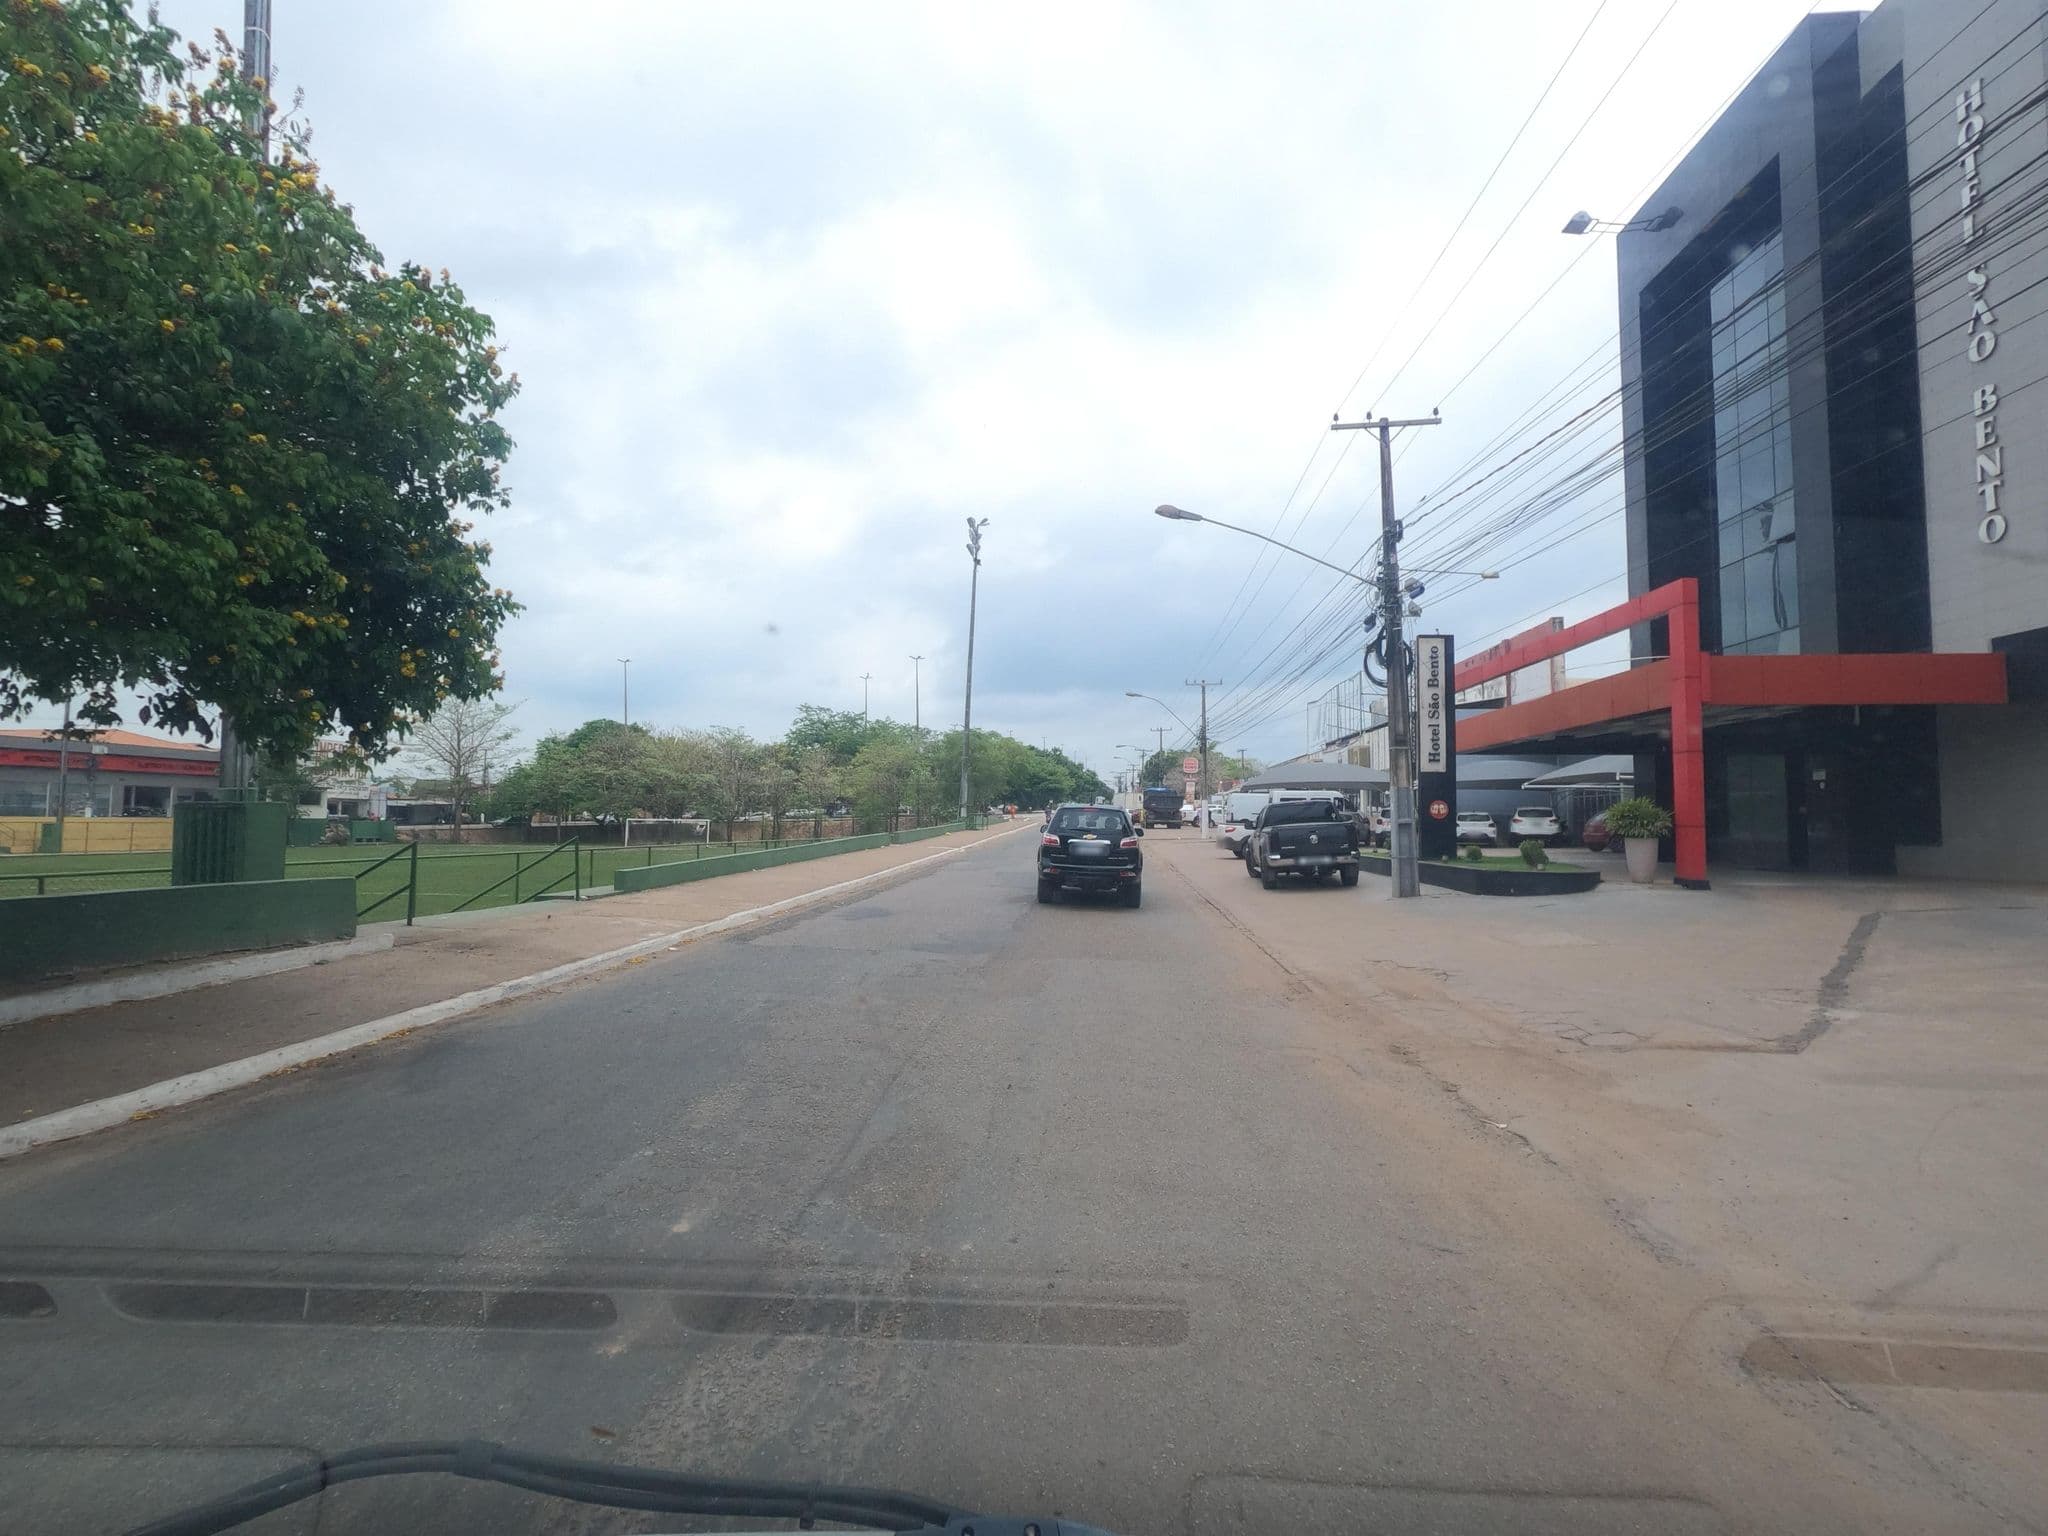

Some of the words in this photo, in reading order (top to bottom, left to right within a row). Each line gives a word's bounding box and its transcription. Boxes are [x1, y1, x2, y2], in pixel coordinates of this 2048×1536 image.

[1956, 77, 1987, 246] HOTEL
[1974, 383, 2006, 544] BENTO
[1427, 645, 1439, 689] Bento
[1428, 692, 1440, 720] São
[1428, 723, 1441, 764] Hotel
